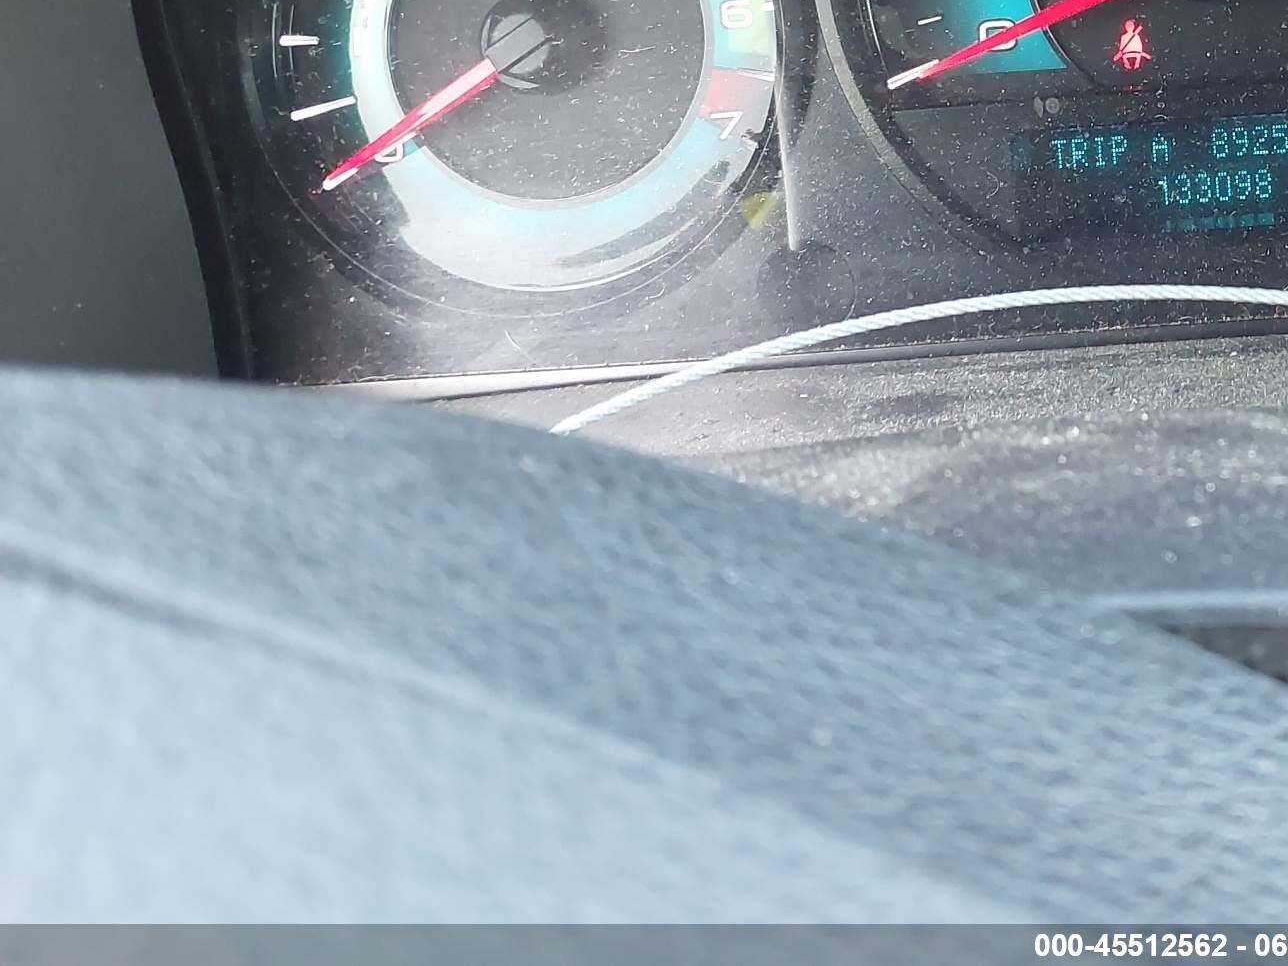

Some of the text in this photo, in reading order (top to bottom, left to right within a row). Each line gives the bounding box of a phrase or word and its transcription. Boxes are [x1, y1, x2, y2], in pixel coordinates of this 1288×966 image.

[720, 0, 754, 30] 6
[709, 111, 743, 138] 7
[1051, 135, 1127, 169] TRIP
[1152, 134, 1169, 162] A
[1158, 168, 1272, 205] 133098
